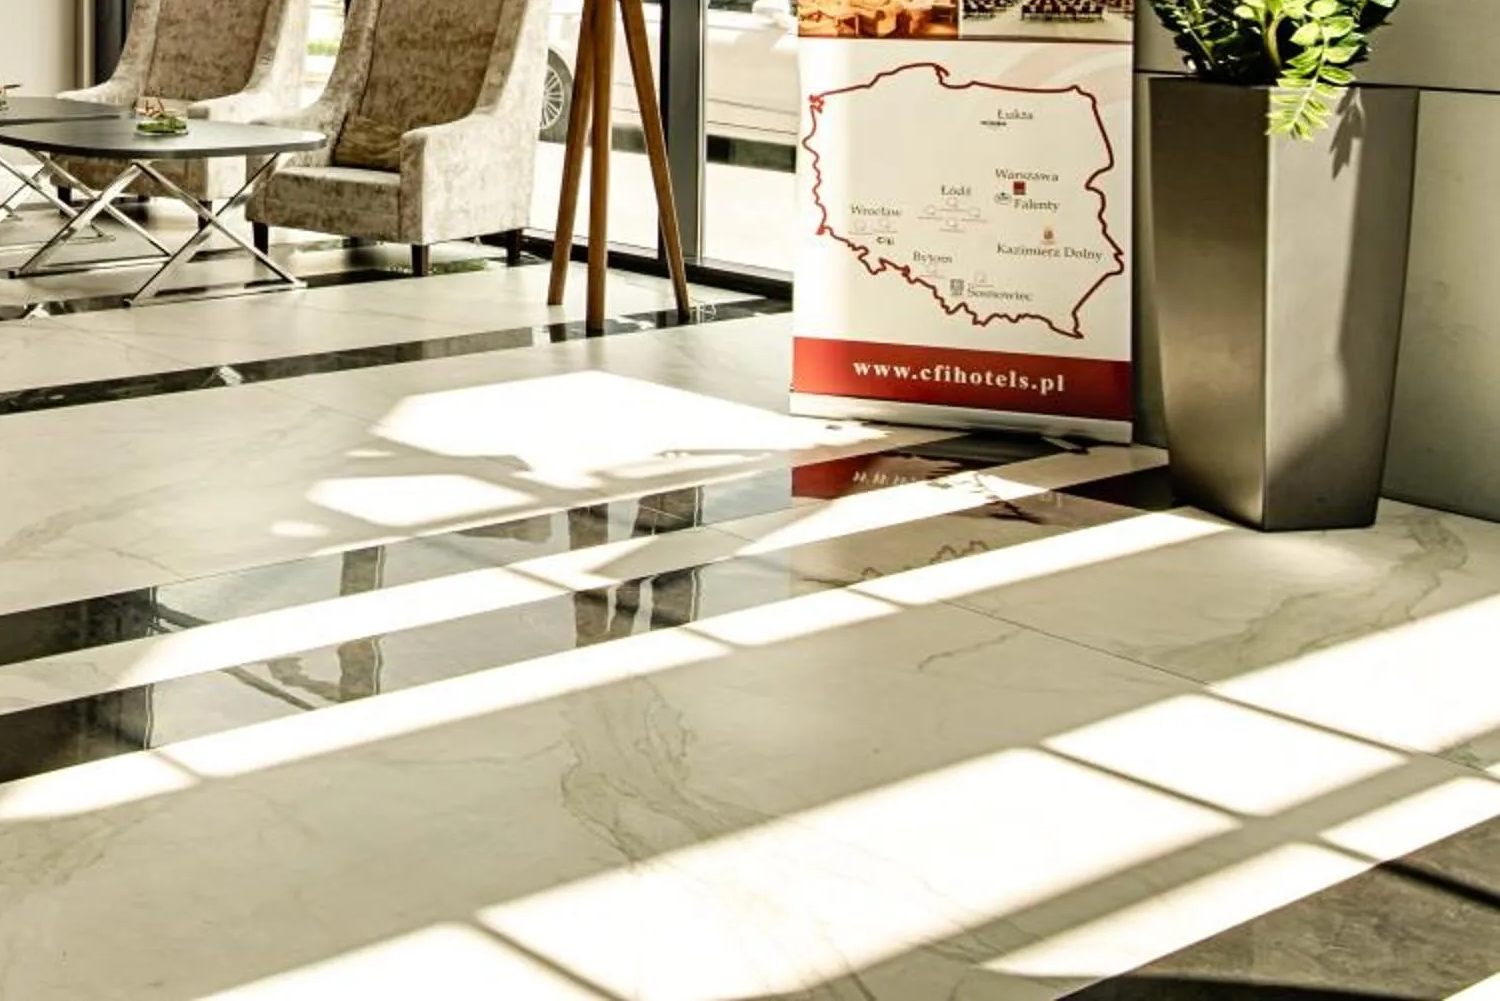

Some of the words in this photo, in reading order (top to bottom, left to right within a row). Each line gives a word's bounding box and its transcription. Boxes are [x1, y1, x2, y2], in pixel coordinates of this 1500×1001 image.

[996, 243, 1061, 258] Kazimierz
[1064, 246, 1104, 263] Dolny
[852, 360, 1066, 395] www.cfihotels.pl
